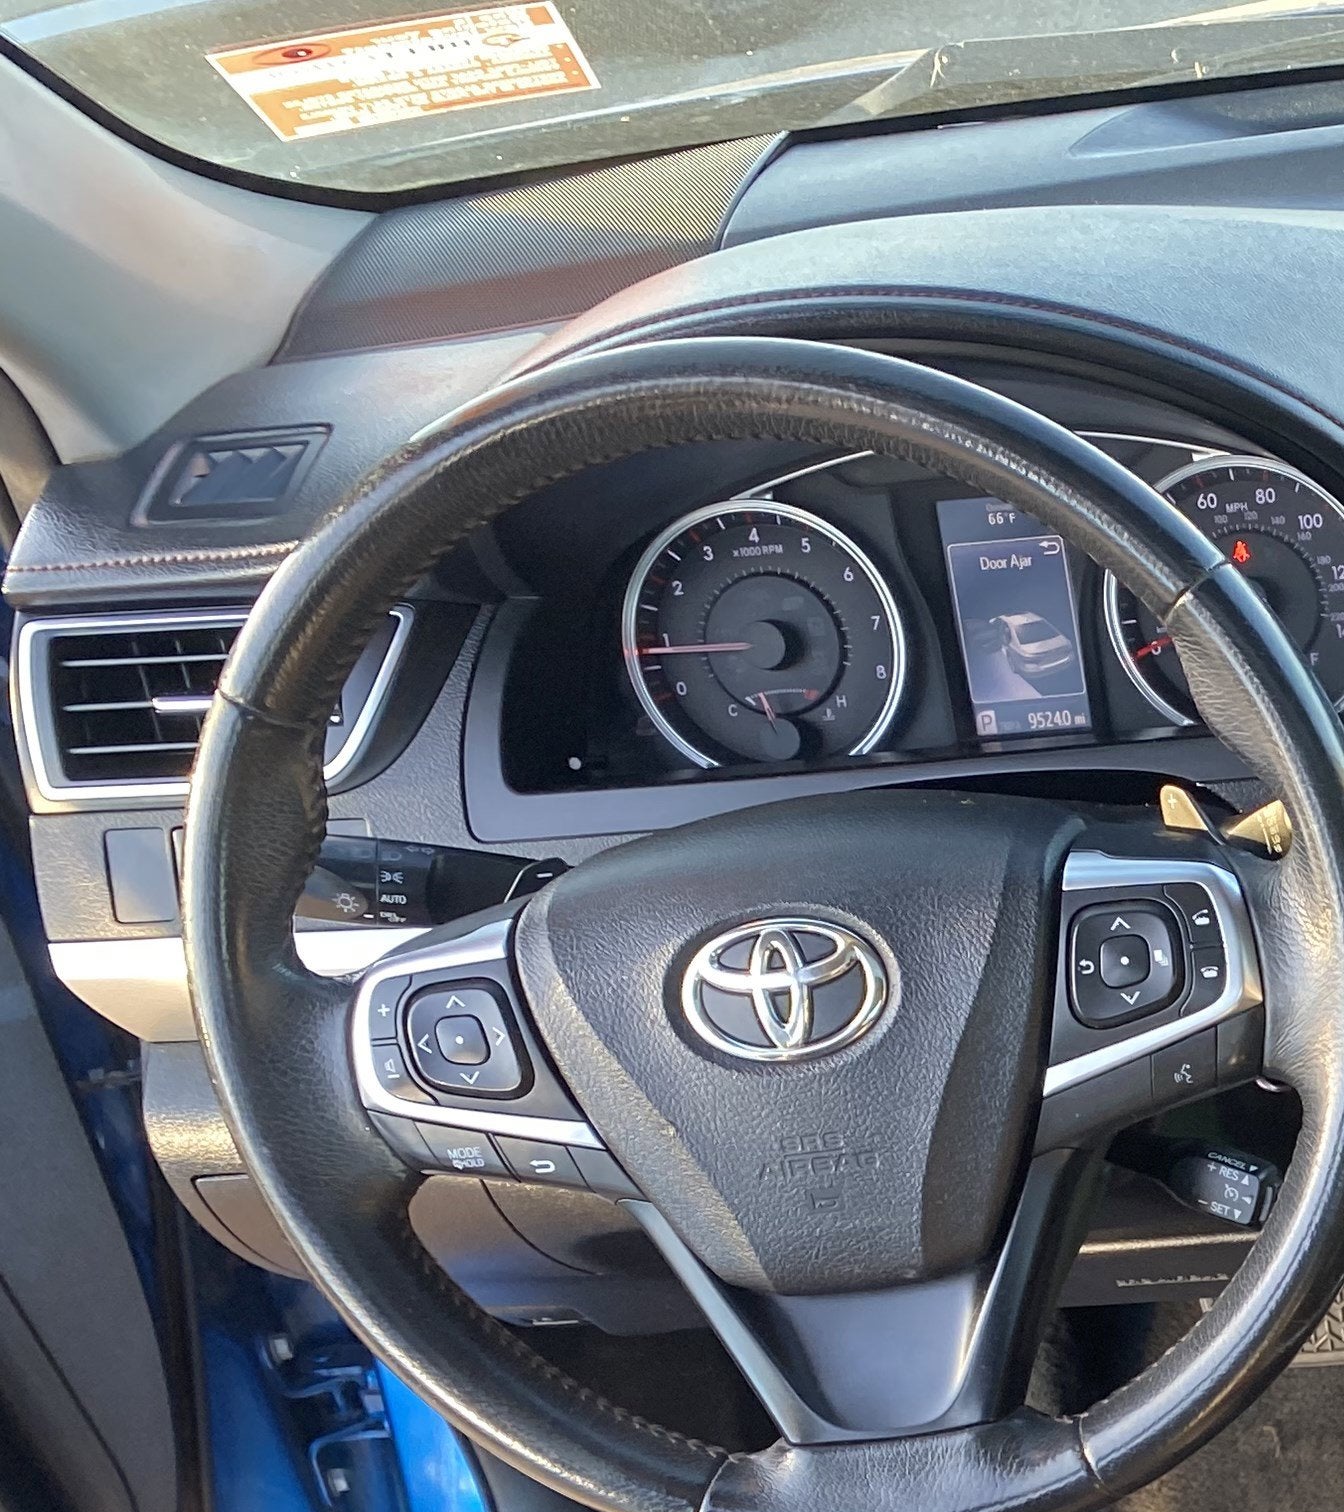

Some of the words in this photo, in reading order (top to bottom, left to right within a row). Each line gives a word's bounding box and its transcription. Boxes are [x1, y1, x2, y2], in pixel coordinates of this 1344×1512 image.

[1197, 493, 1217, 509] 60
[1255, 488, 1276, 504] 80
[1226, 502, 1248, 513] MPH
[1298, 514, 1323, 530] 100
[749, 527, 760, 543] 4
[762, 544, 783, 555] RPM
[801, 537, 811, 553] 5
[703, 546, 714, 561] 3
[980, 556, 1007, 570] Door
[1010, 553, 1032, 570] Ajar
[843, 567, 854, 582] 6
[672, 580, 684, 596] 2
[870, 615, 881, 630] 7
[1310, 652, 1320, 666] F
[875, 664, 887, 680] 8
[676, 681, 687, 696] 0
[836, 696, 847, 708] H
[728, 704, 738, 717] C
[981, 714, 993, 731] P
[380, 894, 407, 905] AUTO
[447, 1146, 482, 1160] MODE
[1207, 1152, 1247, 1170] CANCEL
[1219, 1166, 1240, 1181] RES
[1210, 1201, 1231, 1216] SET
